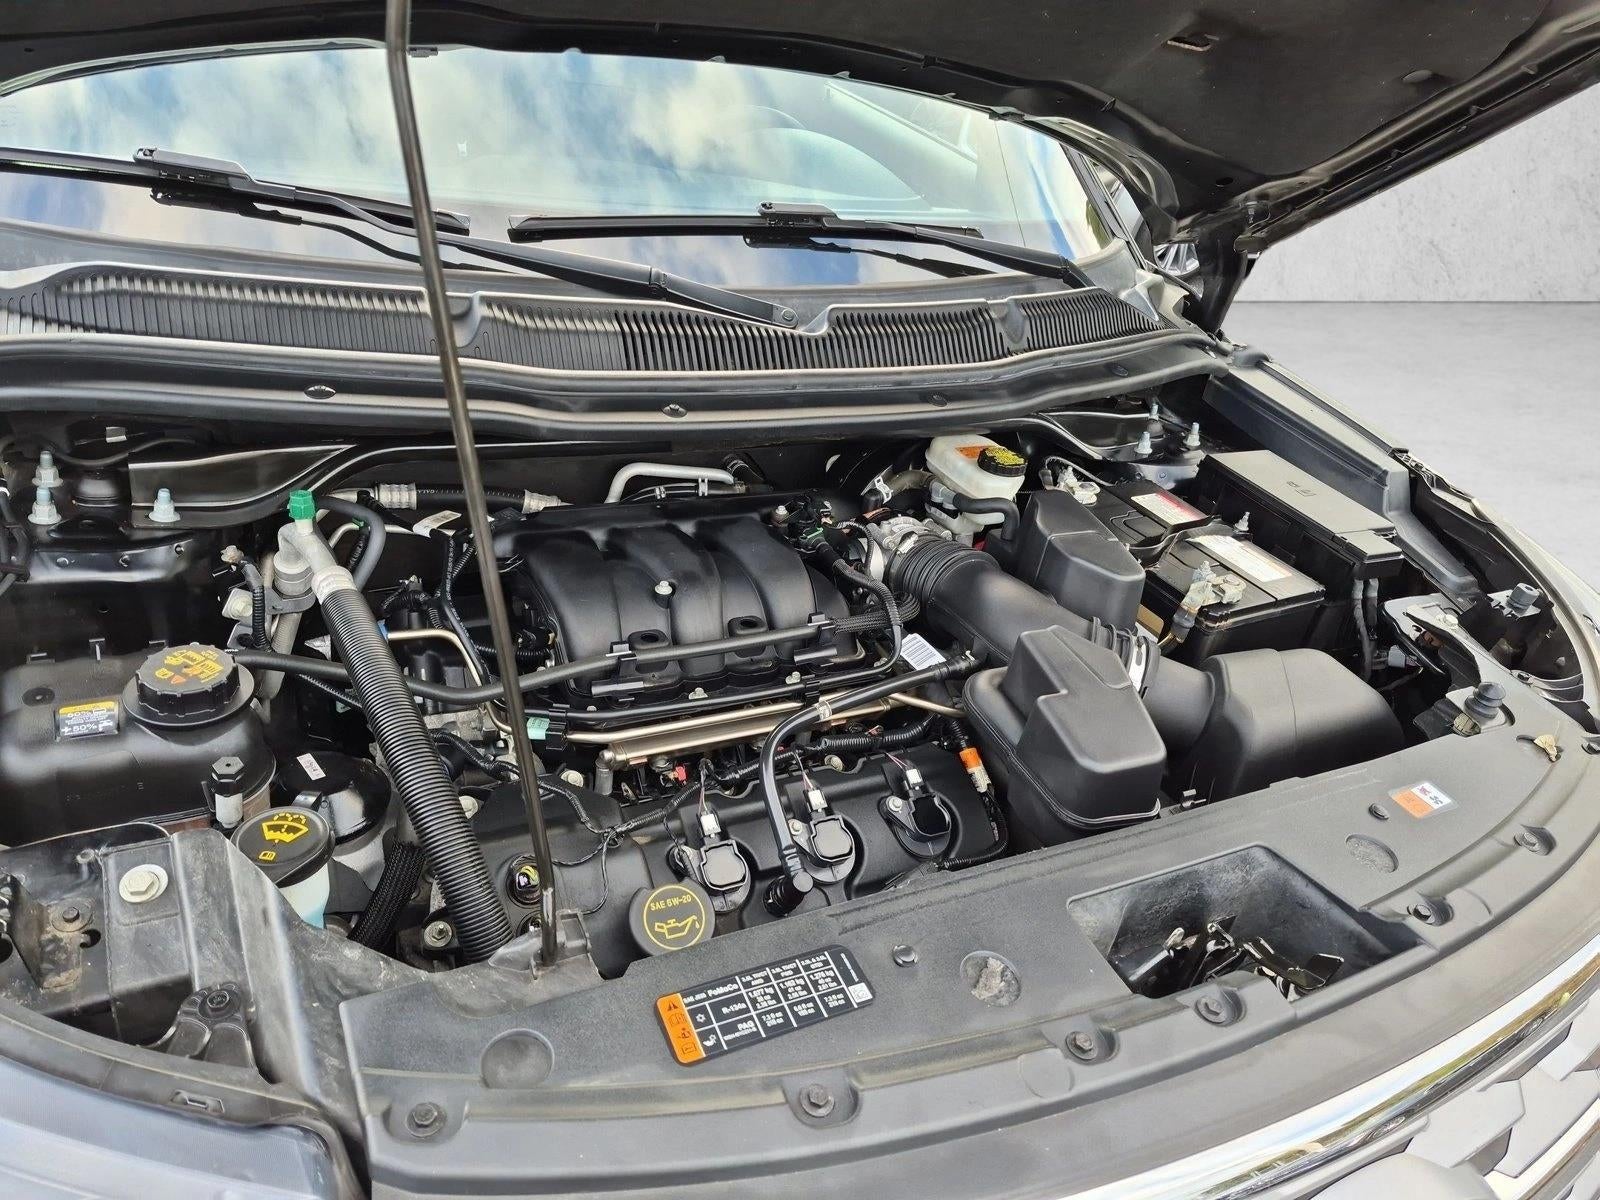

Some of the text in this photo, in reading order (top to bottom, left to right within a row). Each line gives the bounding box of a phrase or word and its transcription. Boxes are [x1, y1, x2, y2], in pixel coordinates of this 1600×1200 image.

[650, 894, 692, 911] SAE 5W-20
[707, 983, 739, 997] FoMoCo
[748, 988, 764, 998] 1.077
[721, 1002, 747, 1014] R-134a
[737, 1020, 755, 1031] PAG
